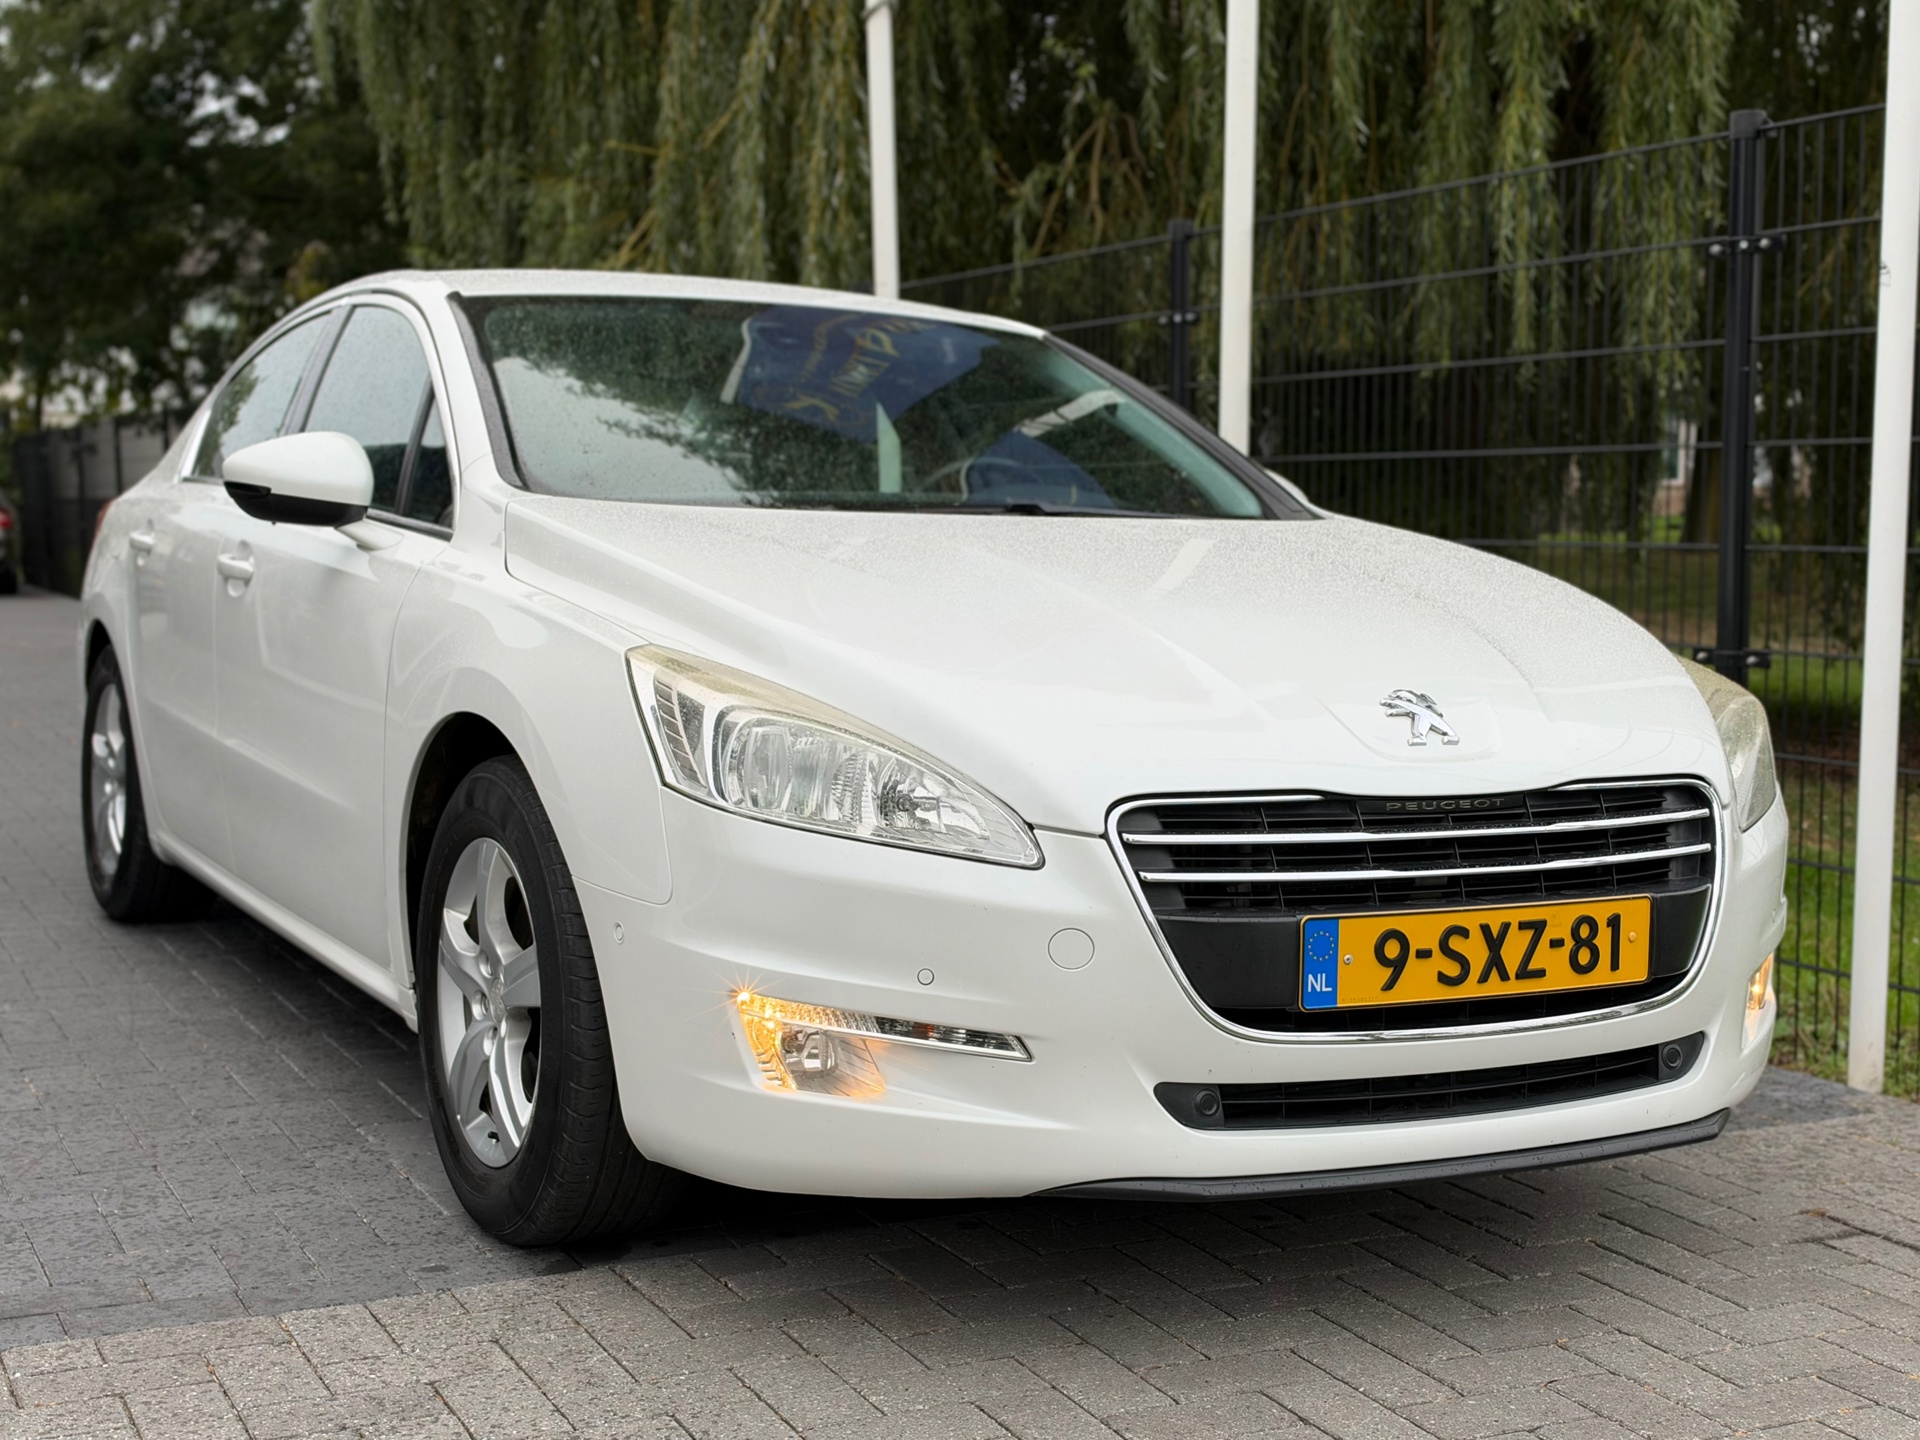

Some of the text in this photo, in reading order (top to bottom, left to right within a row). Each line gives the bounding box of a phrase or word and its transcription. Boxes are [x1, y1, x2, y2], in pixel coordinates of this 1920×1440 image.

[1386, 798, 1504, 811] PEUGEOT
[1374, 913, 1621, 991] 9-SXZ-81
[1307, 973, 1332, 992] NL
